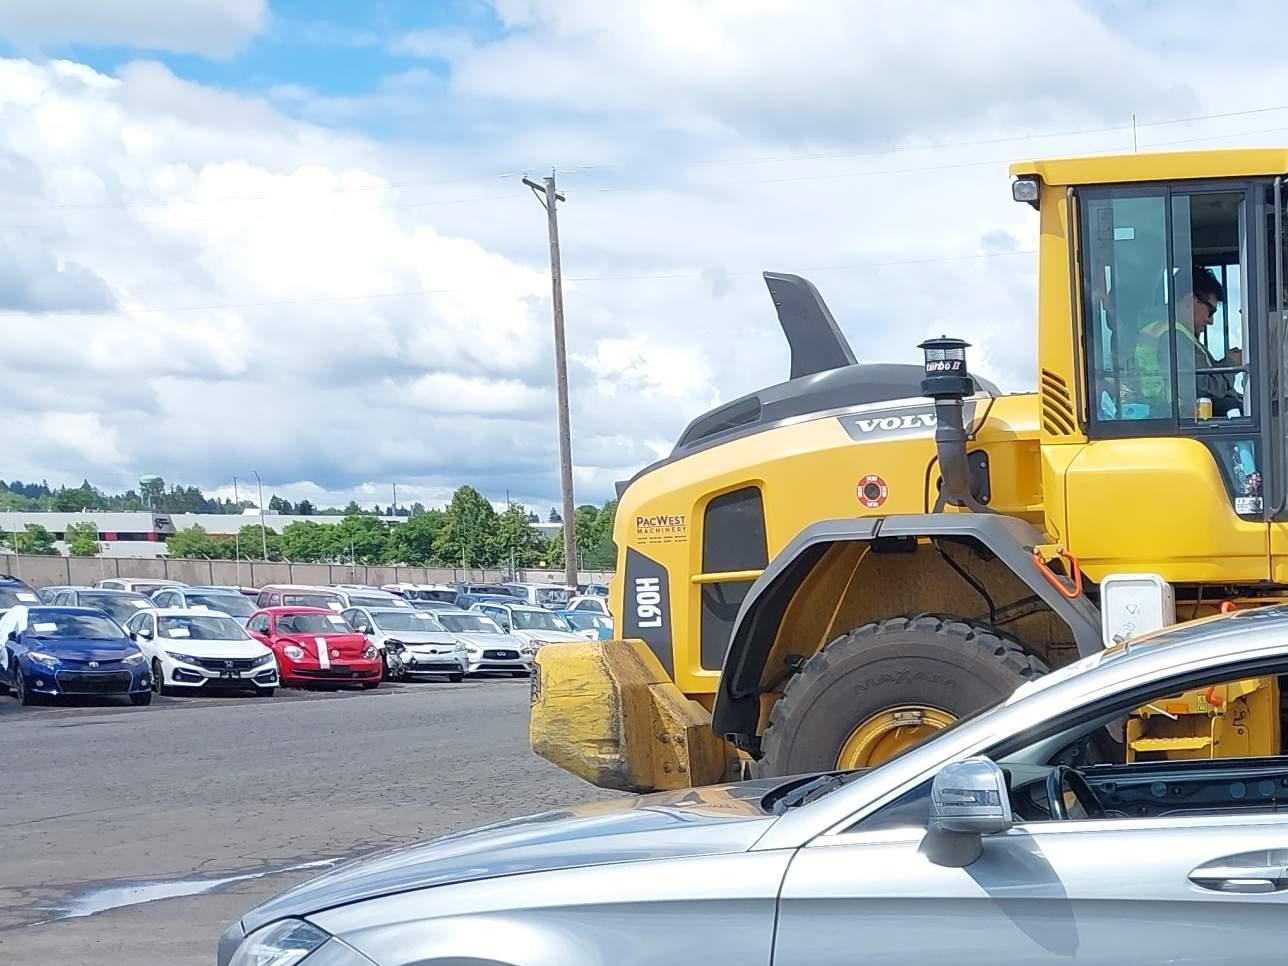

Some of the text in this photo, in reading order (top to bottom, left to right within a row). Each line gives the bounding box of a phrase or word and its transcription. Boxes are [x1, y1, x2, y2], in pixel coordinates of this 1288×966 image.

[926, 361, 951, 372] turbo
[855, 414, 937, 433] VOLV
[635, 577, 662, 628] L90H
